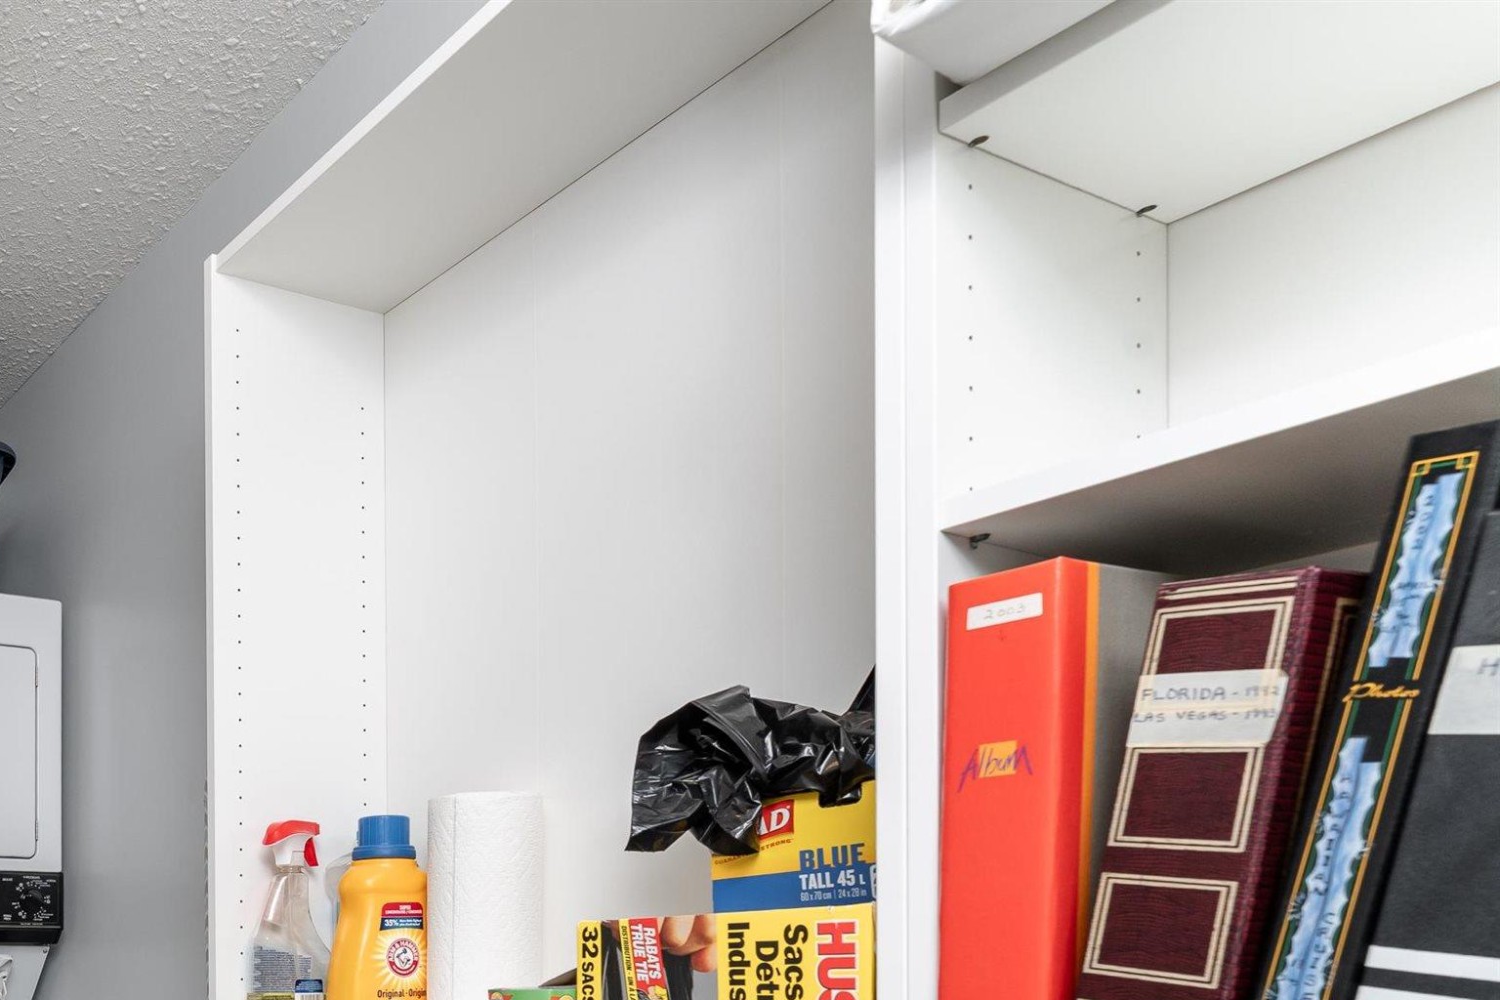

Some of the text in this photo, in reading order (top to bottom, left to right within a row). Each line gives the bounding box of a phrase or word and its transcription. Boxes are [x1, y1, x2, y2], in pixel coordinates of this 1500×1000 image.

[1141, 686, 1226, 700] FLORIDA
[1133, 711, 1166, 723] LAS
[1177, 709, 1227, 721] VEGAS
[957, 746, 1033, 793] Album
[799, 843, 866, 871] BLUE
[799, 871, 834, 890] TALL
[837, 869, 856, 887] 45
[859, 873, 866, 885] L
[582, 926, 599, 959] 32
[620, 925, 633, 971] DISTRIBUTION
[630, 923, 649, 984] TRUE TIE
[643, 927, 662, 980] RABATS
[784, 924, 809, 1000] Sacs
[377, 989, 405, 1000] Original
